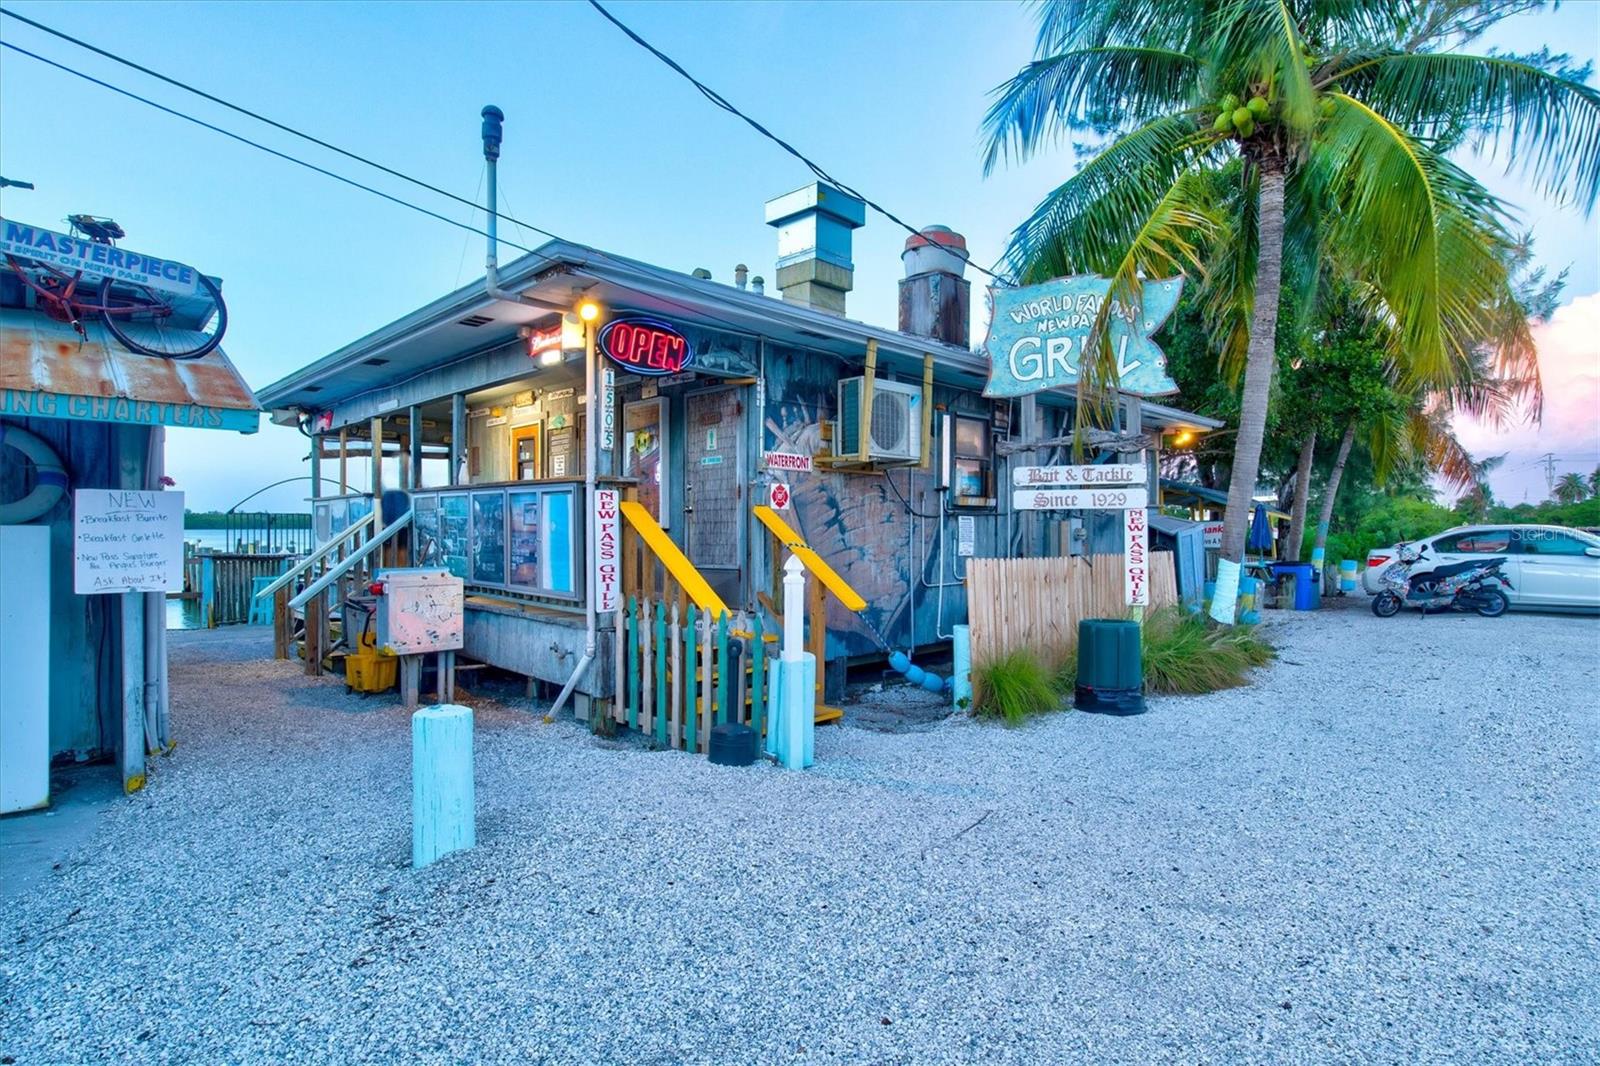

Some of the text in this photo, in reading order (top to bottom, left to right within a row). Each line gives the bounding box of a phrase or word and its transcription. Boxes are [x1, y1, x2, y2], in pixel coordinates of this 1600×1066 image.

[6, 222, 193, 285] MASTERPIECE
[14, 246, 57, 261] SPIRIT
[60, 256, 81, 267] ON
[84, 261, 116, 275] NEW
[118, 270, 149, 283] PASS
[1010, 295, 1072, 324] WORLD
[611, 323, 684, 372] OPEN
[1009, 335, 1142, 381] GRL
[68, 394, 224, 427] CHARTERS
[766, 454, 809, 470] WATERFRONT
[1028, 467, 1134, 484] Bait & Tackle
[109, 492, 156, 508] NEW
[1033, 493, 1128, 508] Since 1929
[84, 514, 130, 525] Breakfast
[82, 532, 127, 543] Breakfast
[101, 552, 119, 561] Pass
[598, 492, 615, 610] NEW PASS GRILL
[1128, 510, 1144, 604] NEW PASS GRILL
[94, 576, 114, 586] Ask
[121, 574, 145, 585] About
